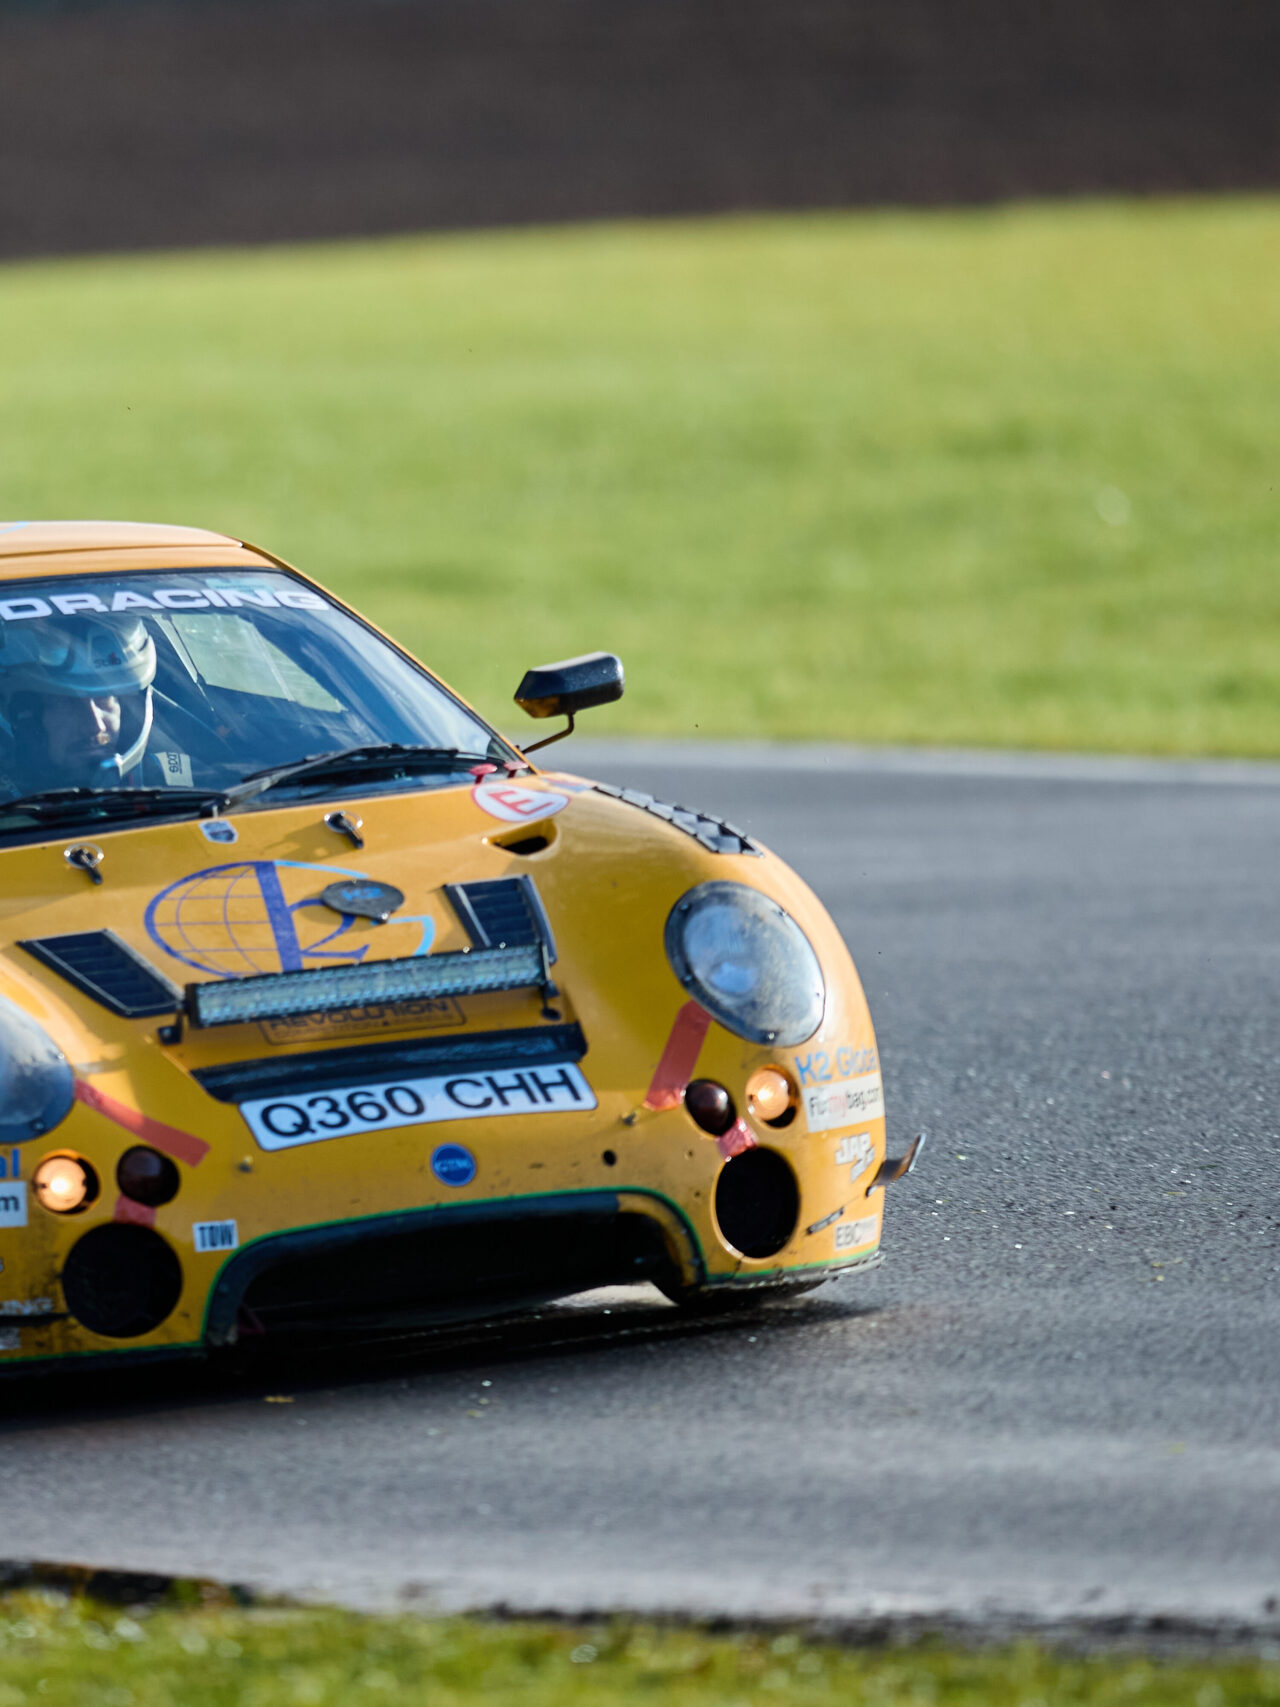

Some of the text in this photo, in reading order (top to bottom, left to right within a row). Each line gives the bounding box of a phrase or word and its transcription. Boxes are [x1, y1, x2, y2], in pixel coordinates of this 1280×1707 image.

[487, 789, 554, 815] E
[794, 1050, 833, 1086] K2
[259, 1067, 584, 1138] Q360 CHH
[835, 1131, 872, 1166] JAP
[198, 1224, 236, 1248] TOW
